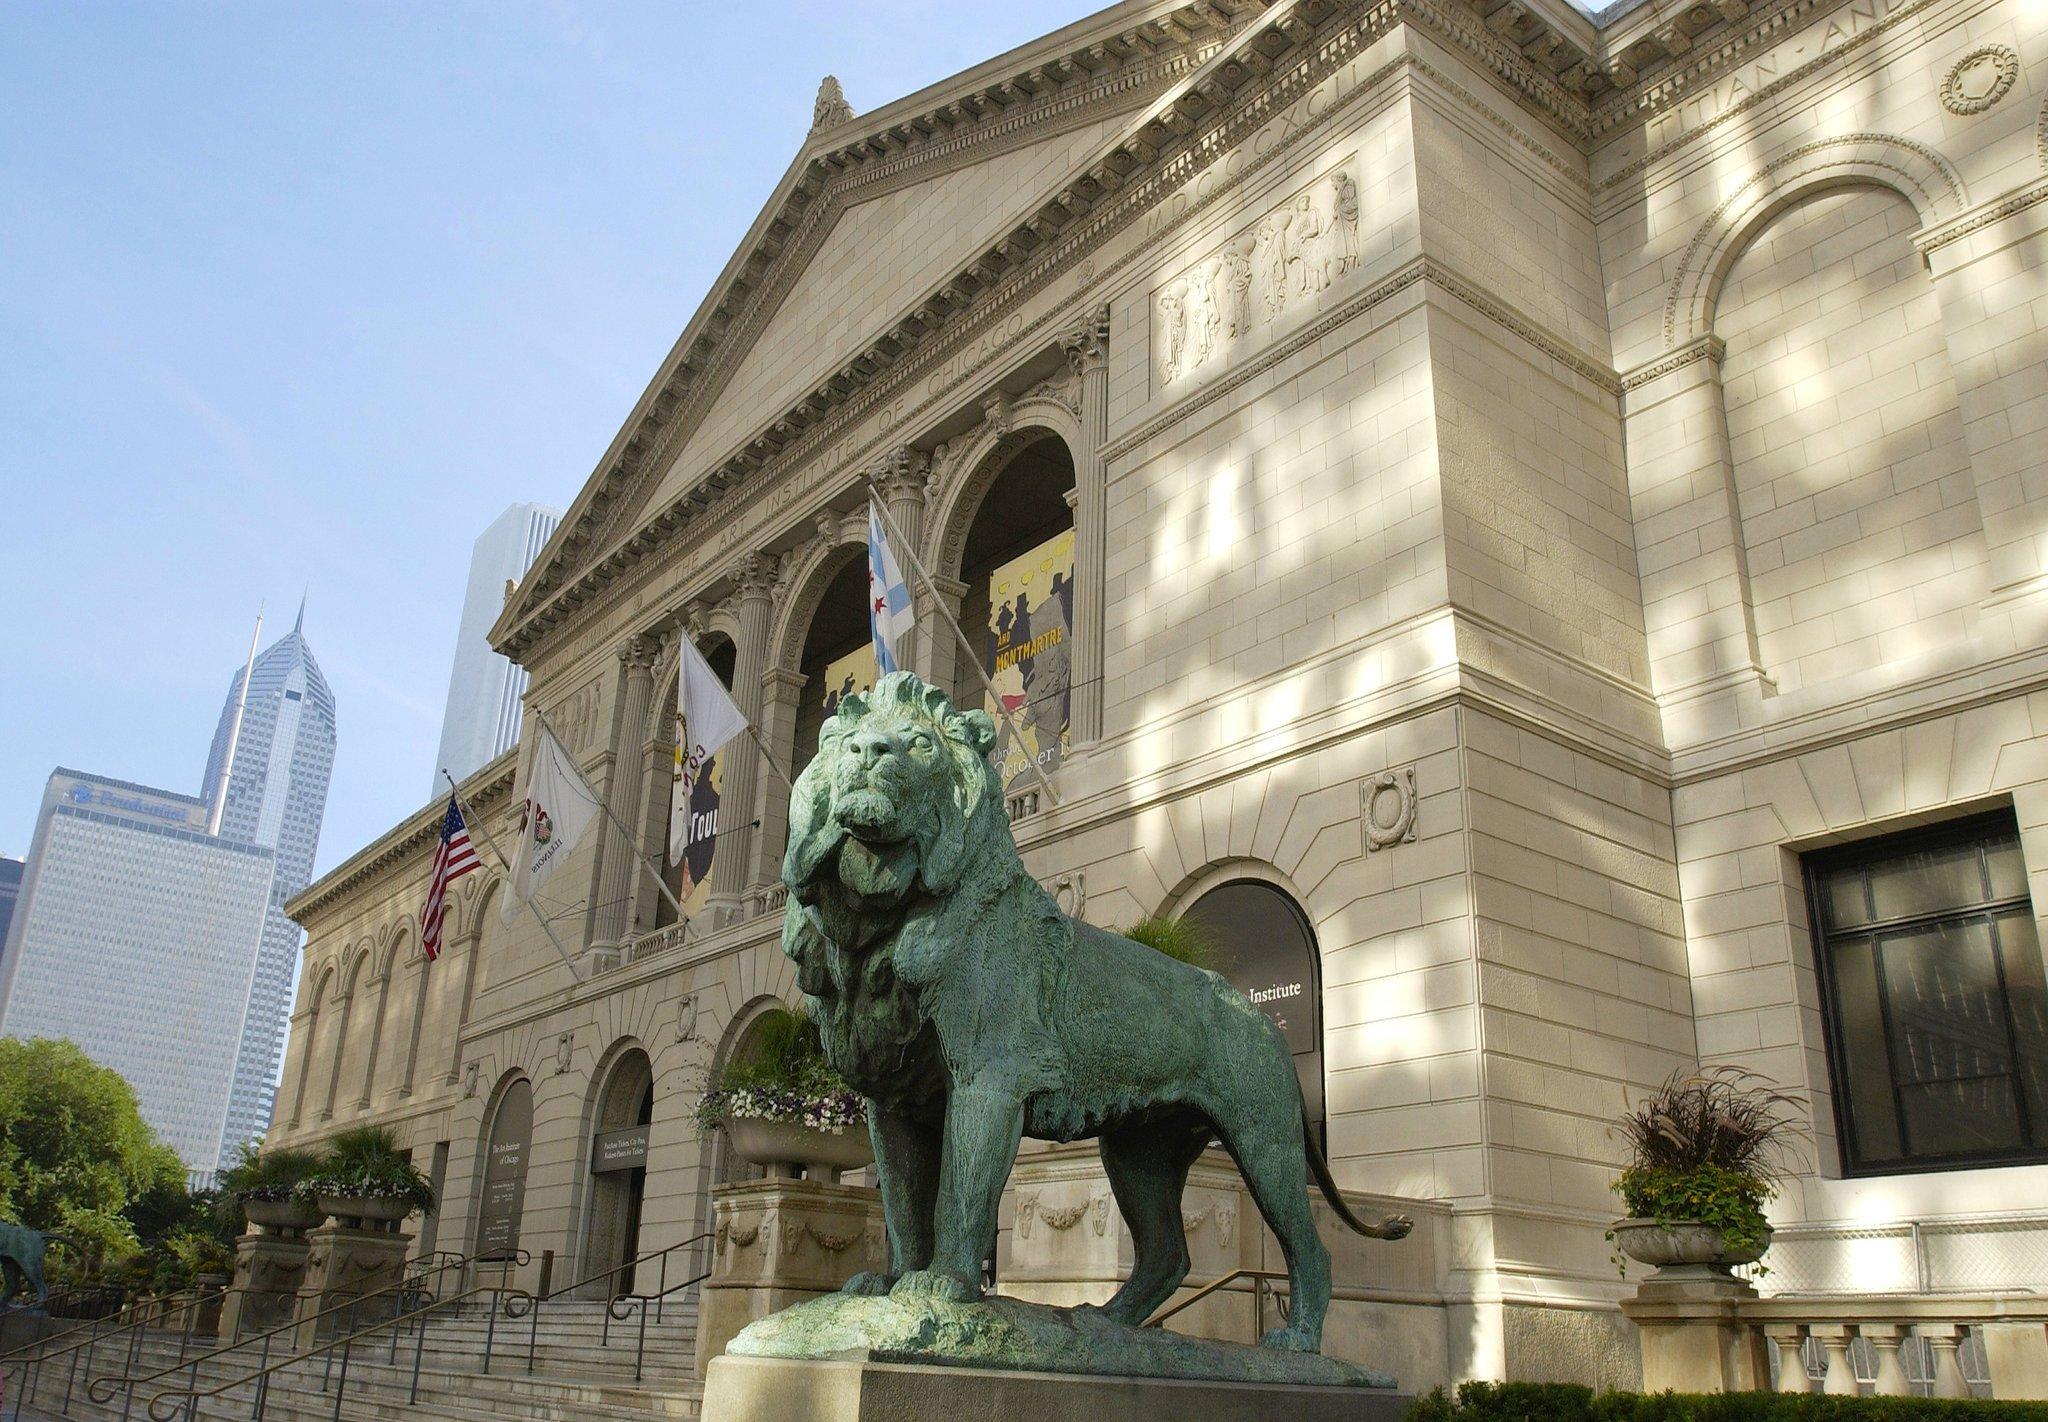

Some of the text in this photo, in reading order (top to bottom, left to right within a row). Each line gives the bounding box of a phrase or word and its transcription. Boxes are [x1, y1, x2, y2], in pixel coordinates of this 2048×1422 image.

[1650, 53, 1777, 142] TITIAN
[674, 551, 700, 584] THE
[718, 515, 750, 551] ART
[764, 433, 858, 517] INSTITVTE
[878, 398, 905, 431] OF
[928, 312, 1023, 395] CHICAGO
[995, 626, 1064, 673] MONTMARTRE
[997, 630, 1011, 647] AND
[994, 746, 1055, 778] Octoer
[100, 790, 188, 822] Prudential
[1249, 982, 1301, 1004] Institute
